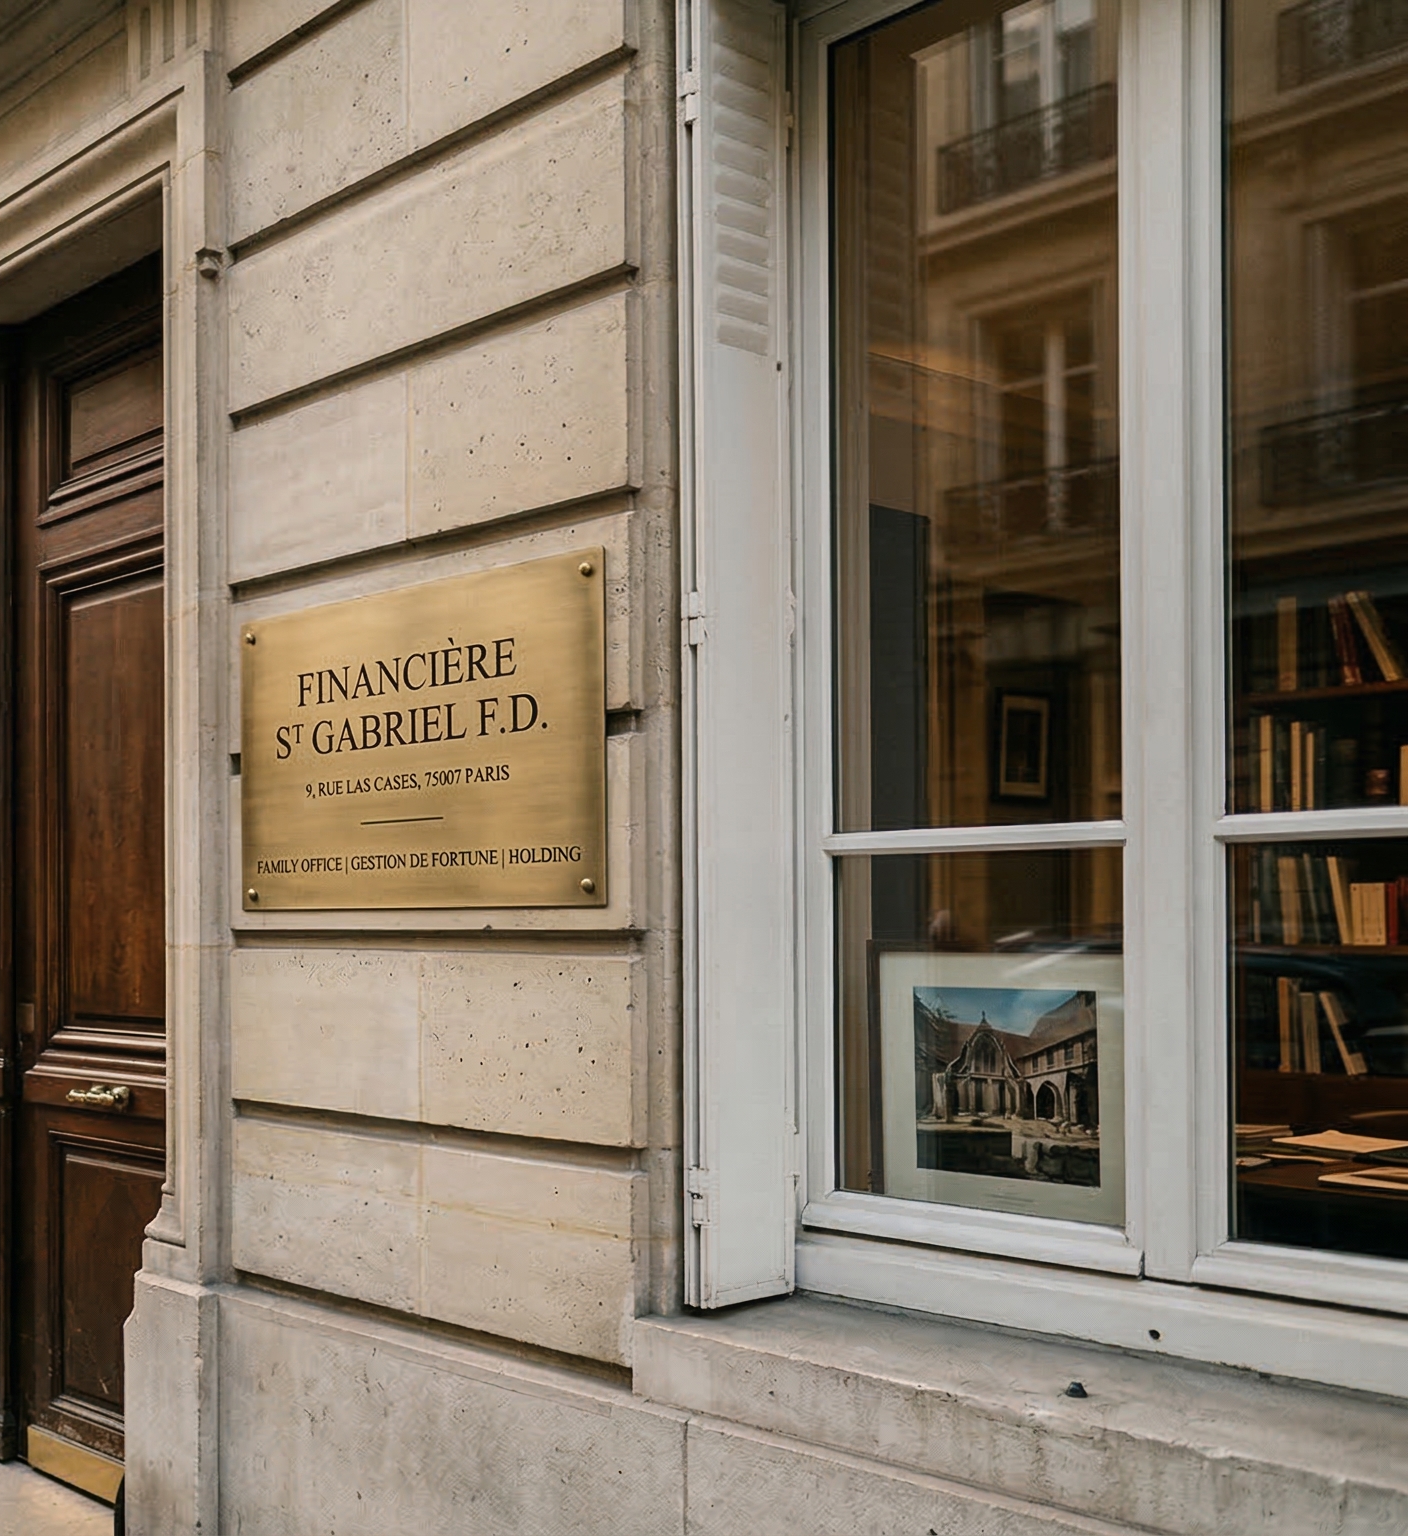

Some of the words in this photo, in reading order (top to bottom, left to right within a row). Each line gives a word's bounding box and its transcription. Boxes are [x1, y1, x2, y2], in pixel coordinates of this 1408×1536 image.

[296, 637, 518, 708] FINANCIÈRE
[311, 702, 468, 755] GABRIEL
[476, 693, 548, 737] F.D.
[305, 784, 316, 799] 9,
[318, 781, 344, 797] RUE
[346, 778, 372, 795] LAS
[373, 773, 422, 792] CASES,
[424, 768, 462, 788] 75007
[465, 764, 510, 784] PARIS
[256, 858, 300, 875] FAMILY
[300, 856, 343, 873] OFFICE
[350, 854, 407, 871] GESTION
[409, 852, 429, 869] DE
[431, 849, 499, 868] FORTUNE
[508, 845, 582, 865] HOLDING
